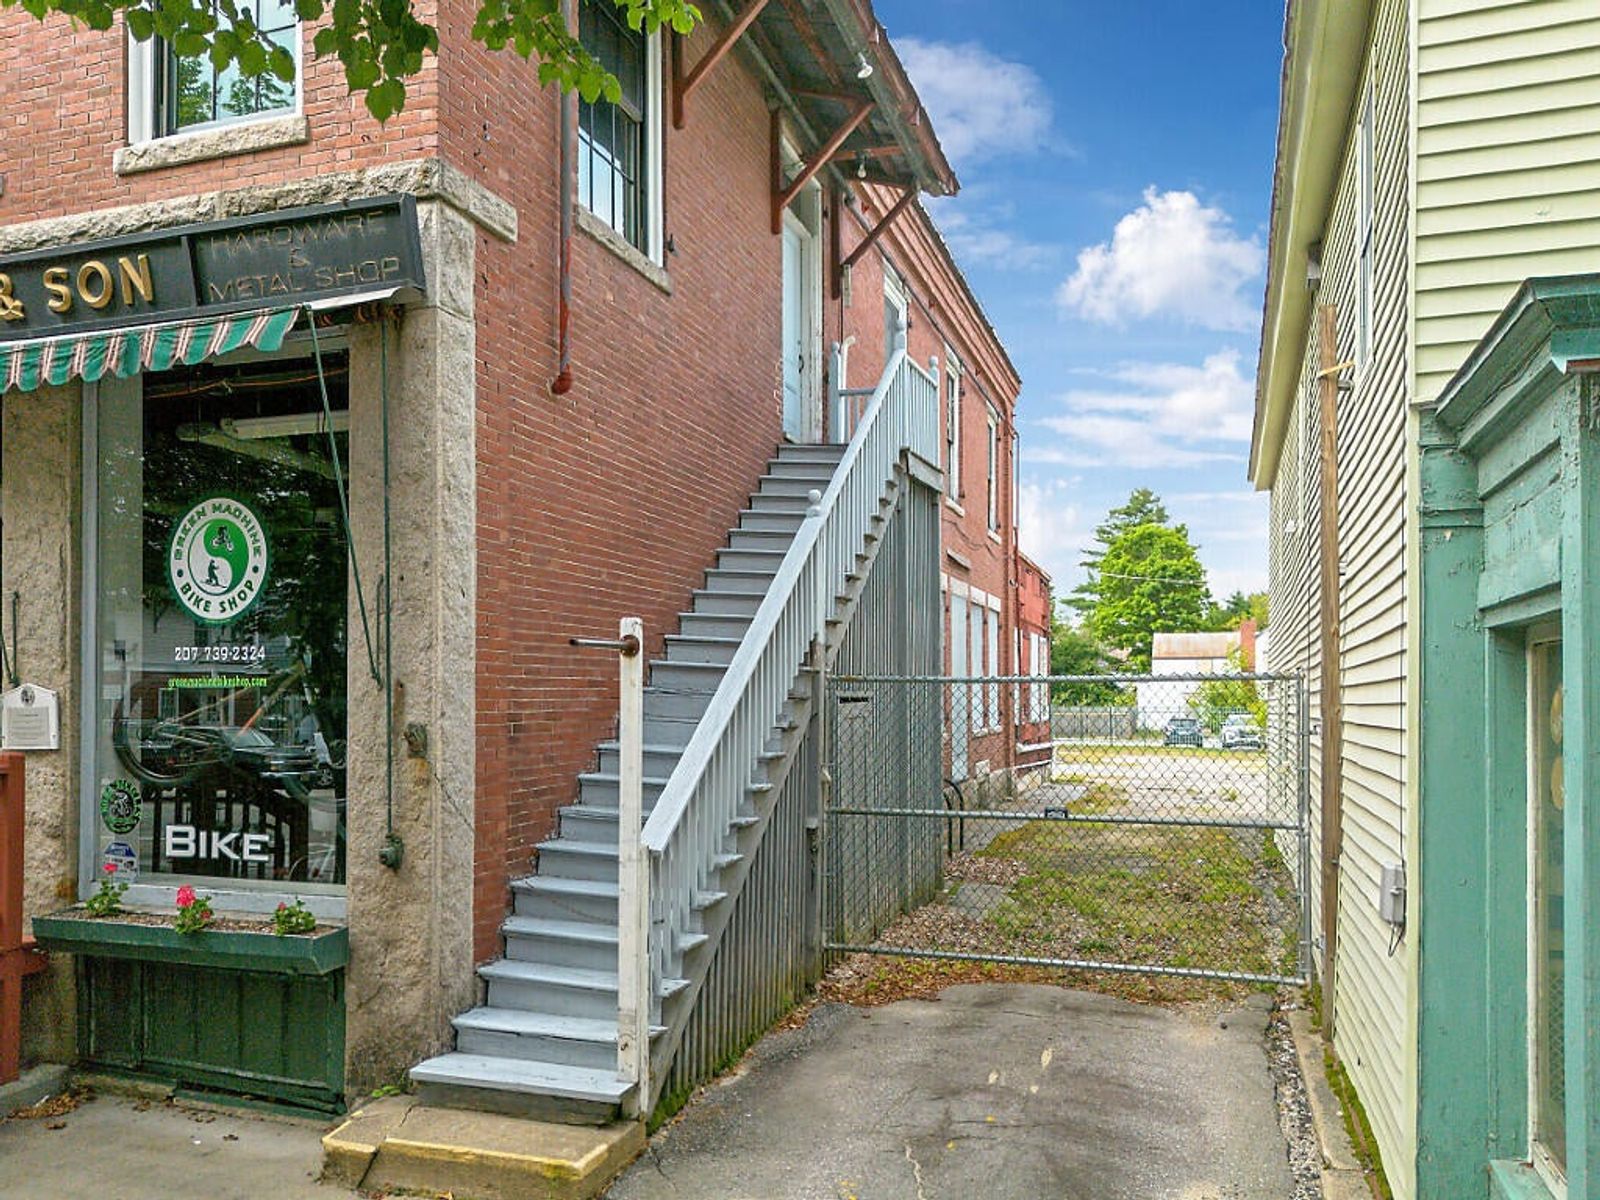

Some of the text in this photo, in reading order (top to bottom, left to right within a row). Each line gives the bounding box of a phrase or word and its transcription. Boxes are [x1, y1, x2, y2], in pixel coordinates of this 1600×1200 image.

[211, 211, 386, 260] HARDWARE
[289, 248, 311, 268] &
[43, 254, 153, 314] SON
[208, 257, 400, 302] METAL SHOP
[174, 504, 261, 560] GREEN MACHINE
[180, 580, 254, 613] BIKE SHOP
[175, 646, 198, 661] 207
[166, 825, 269, 861] BIKE
